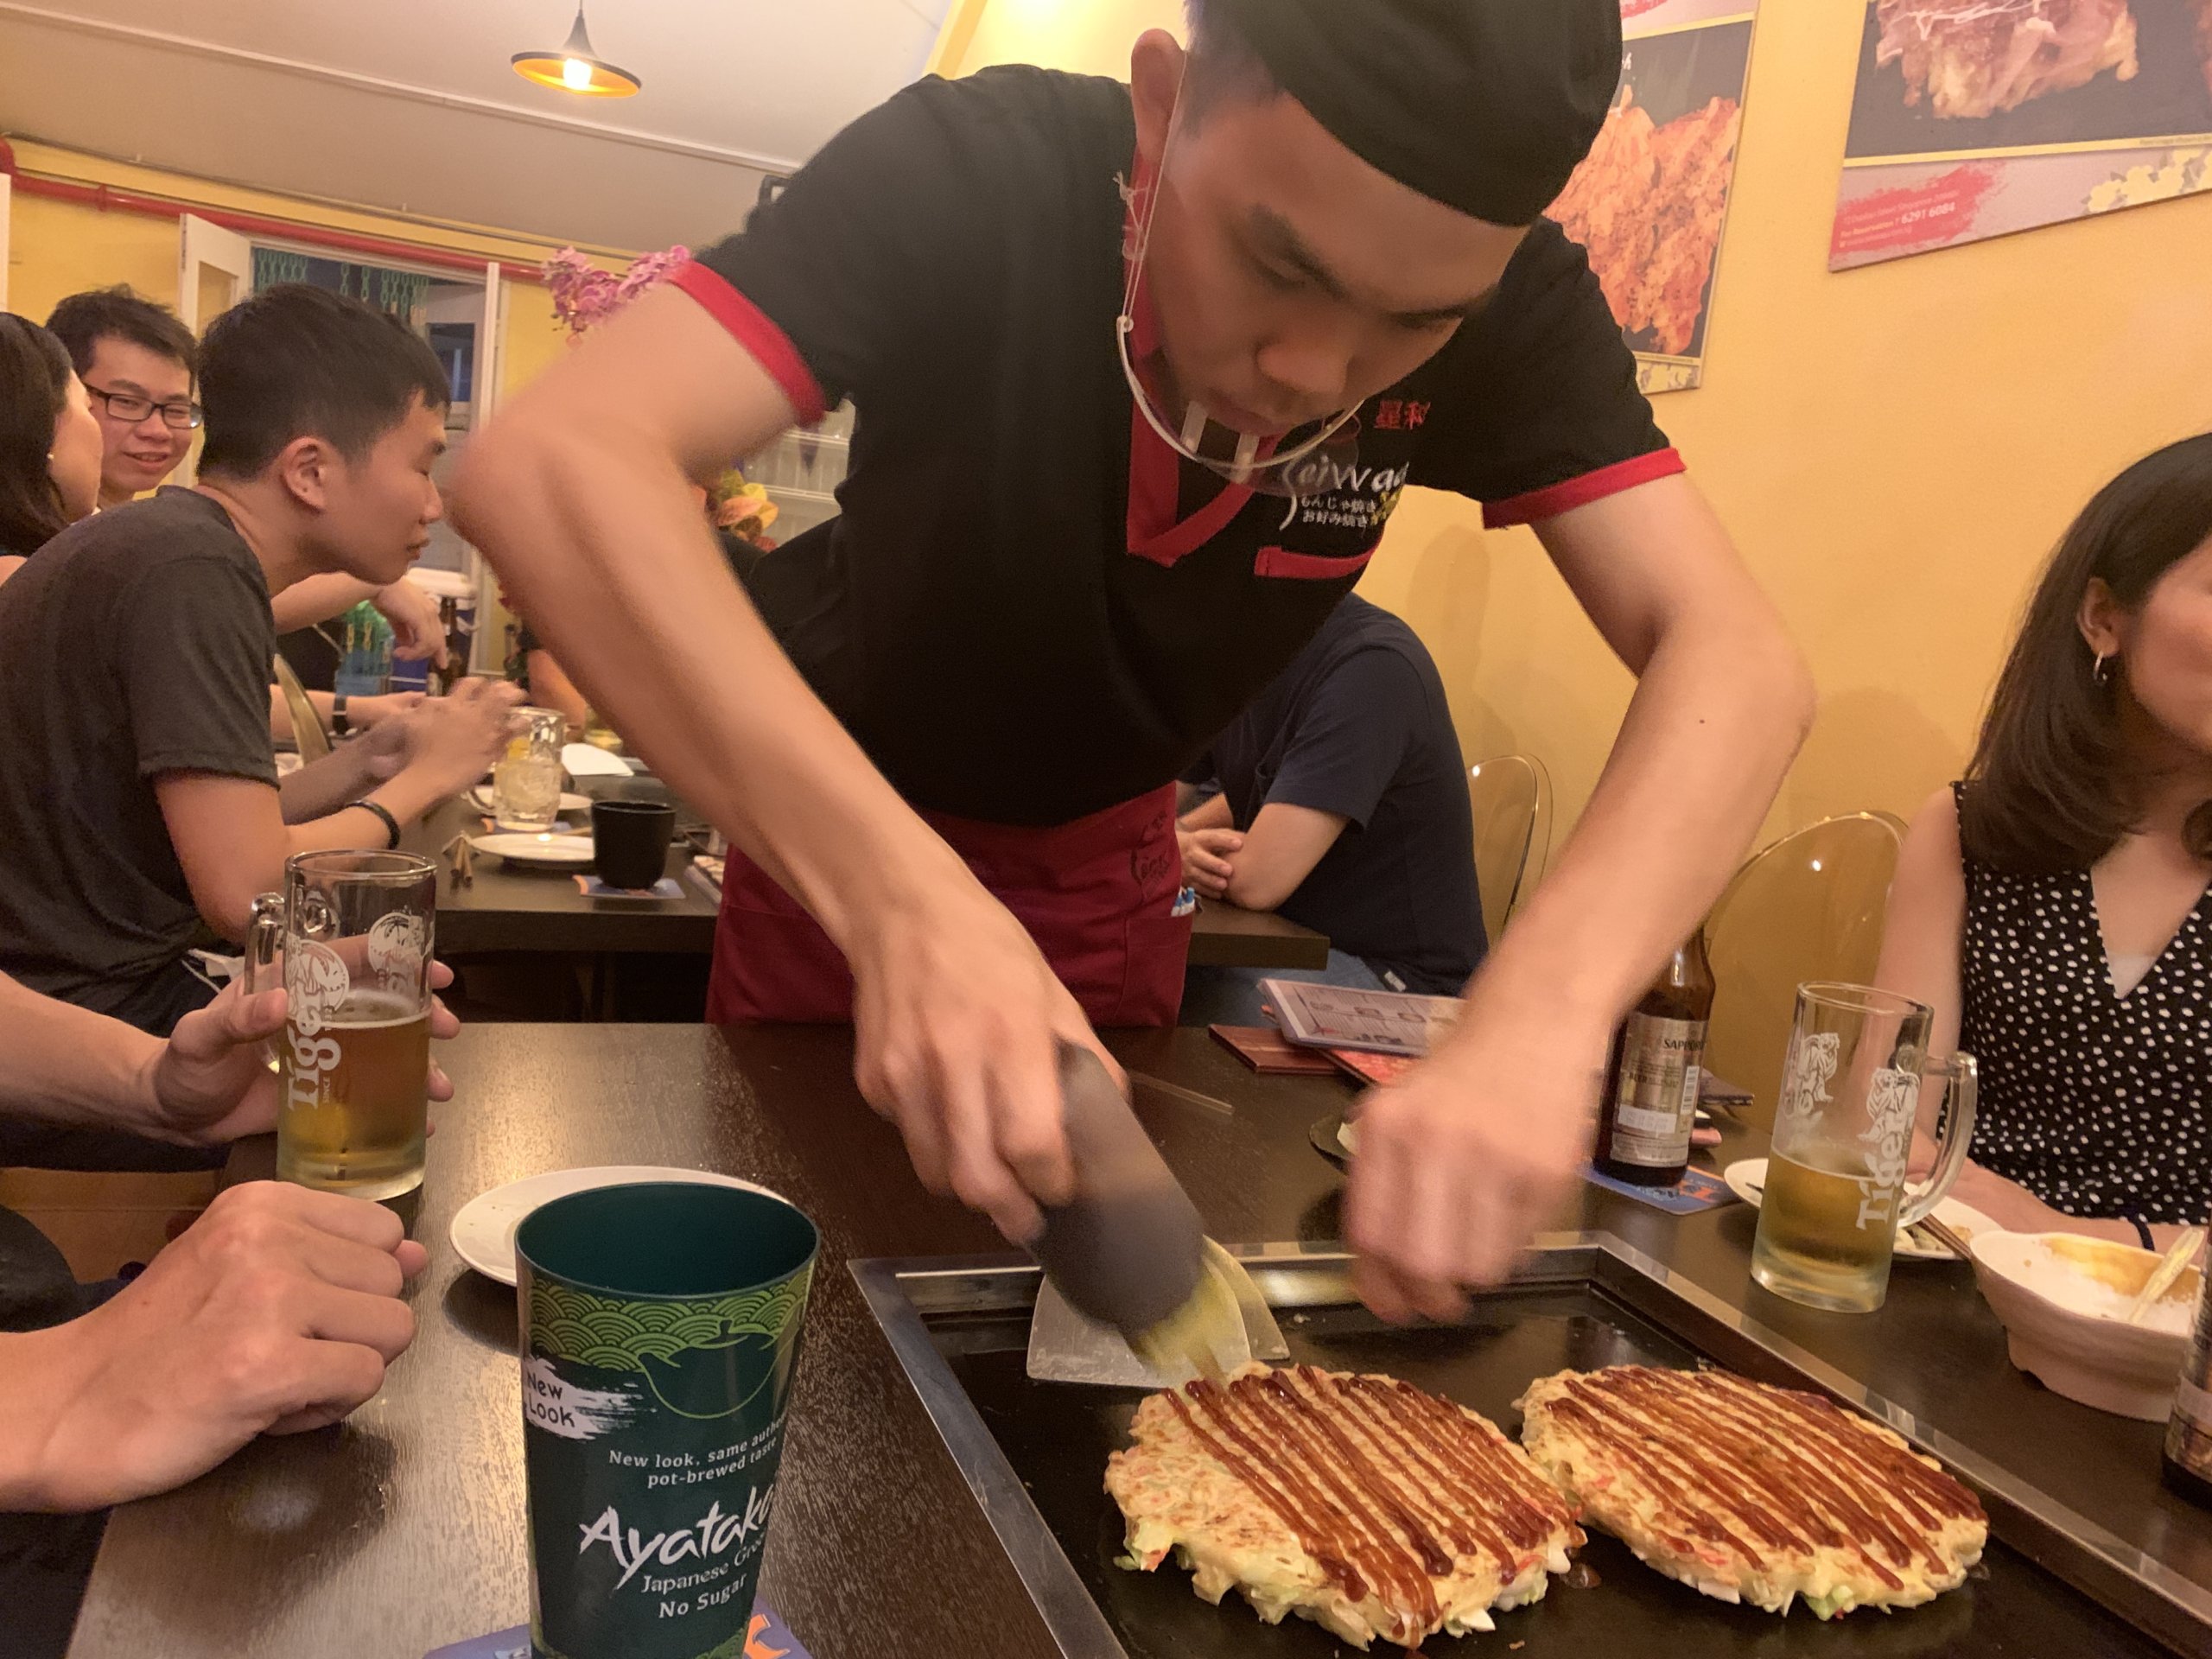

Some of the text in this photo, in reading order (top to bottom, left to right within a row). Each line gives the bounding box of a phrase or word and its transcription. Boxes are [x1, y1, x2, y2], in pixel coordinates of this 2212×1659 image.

[1901, 209, 1926, 224] 6291
[527, 1370, 563, 1400] New
[528, 1392, 575, 1427] Look
[608, 1450, 648, 1468] New
[655, 1452, 700, 1468] look,
[708, 1440, 747, 1463] same
[648, 1436, 777, 1489] pot-brewed taste
[640, 1561, 729, 1595] Japanese
[658, 1573, 747, 1618] No Sugar
